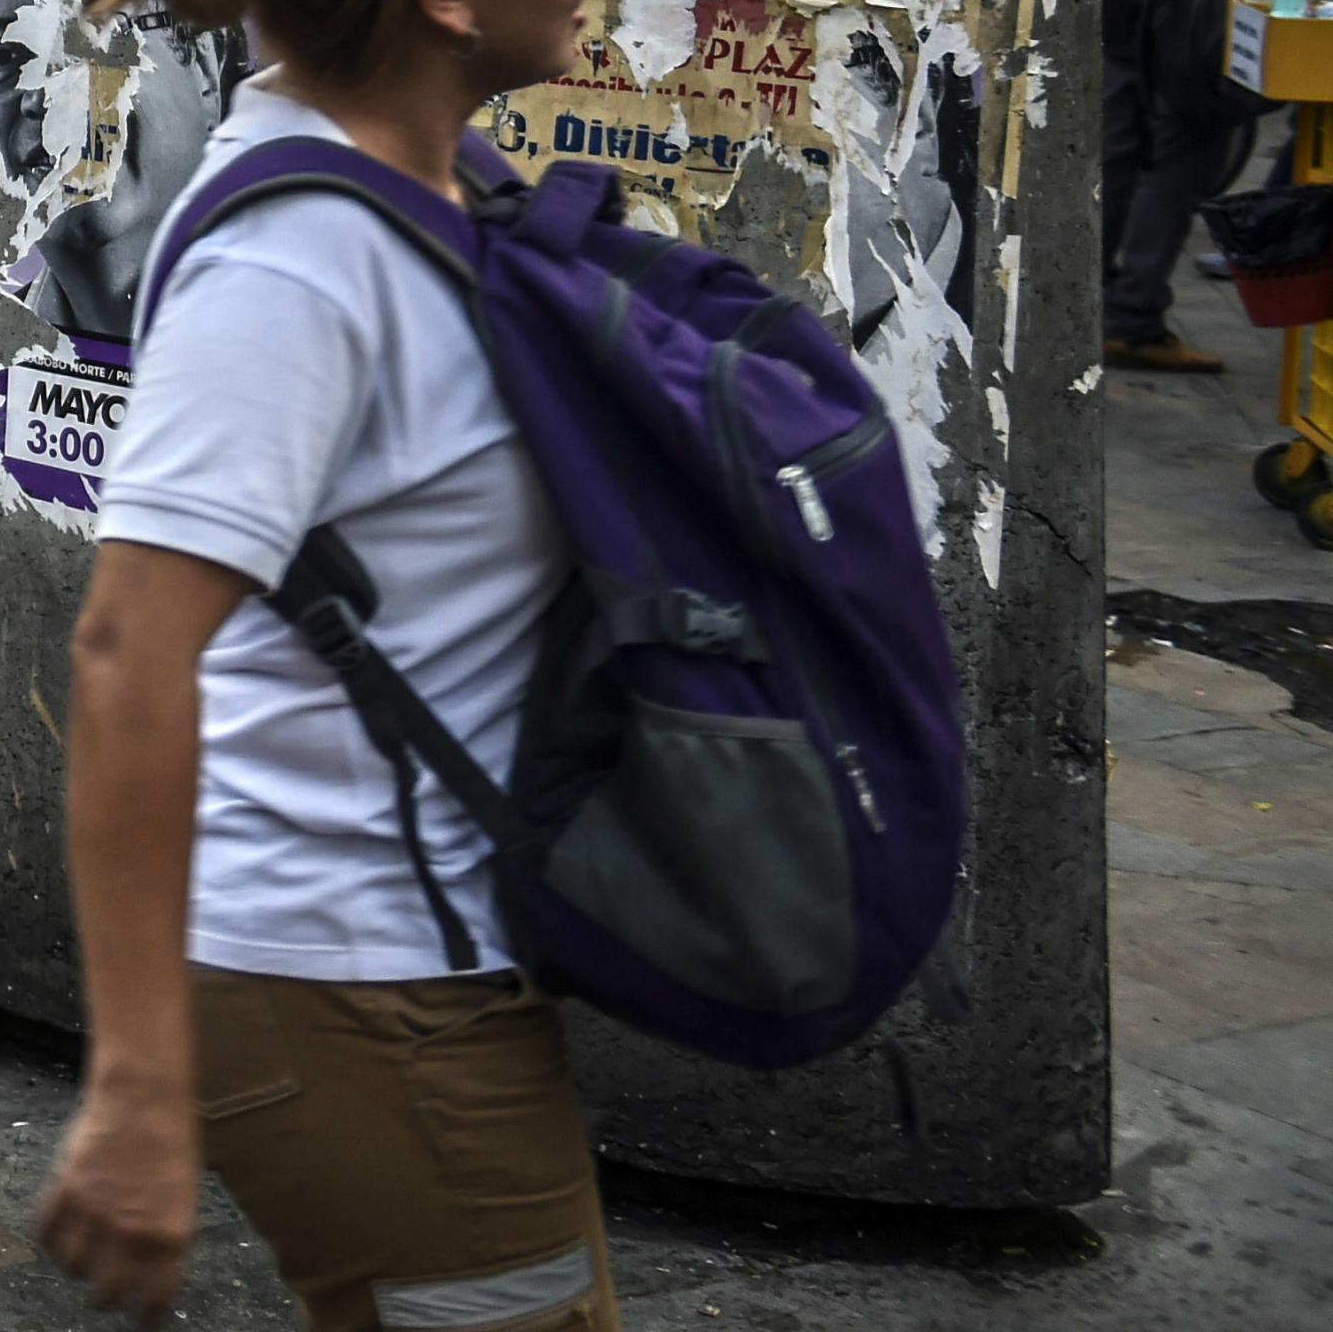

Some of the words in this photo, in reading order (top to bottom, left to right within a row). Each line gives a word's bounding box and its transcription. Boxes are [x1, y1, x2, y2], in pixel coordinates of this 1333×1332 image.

[704, 37, 815, 82] PLAZ
[70, 362, 106, 379] NORTE
[28, 379, 131, 431] MAYO
[26, 419, 105, 467] 3:00
